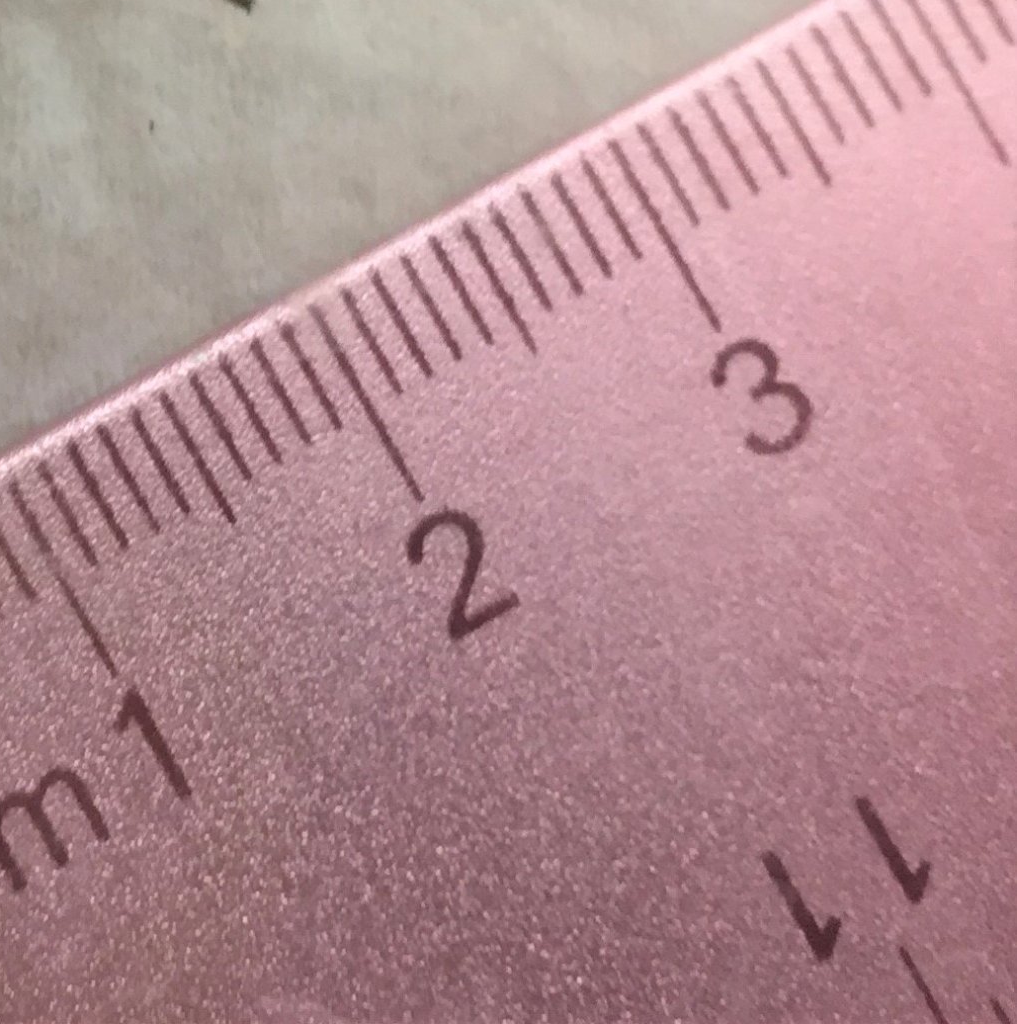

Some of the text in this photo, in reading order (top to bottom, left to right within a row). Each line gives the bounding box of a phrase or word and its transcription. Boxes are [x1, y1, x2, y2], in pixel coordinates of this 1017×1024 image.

[113, 686, 192, 799] 1
[406, 509, 520, 640] 2
[710, 337, 814, 456] 3
[762, 796, 932, 961] 11
